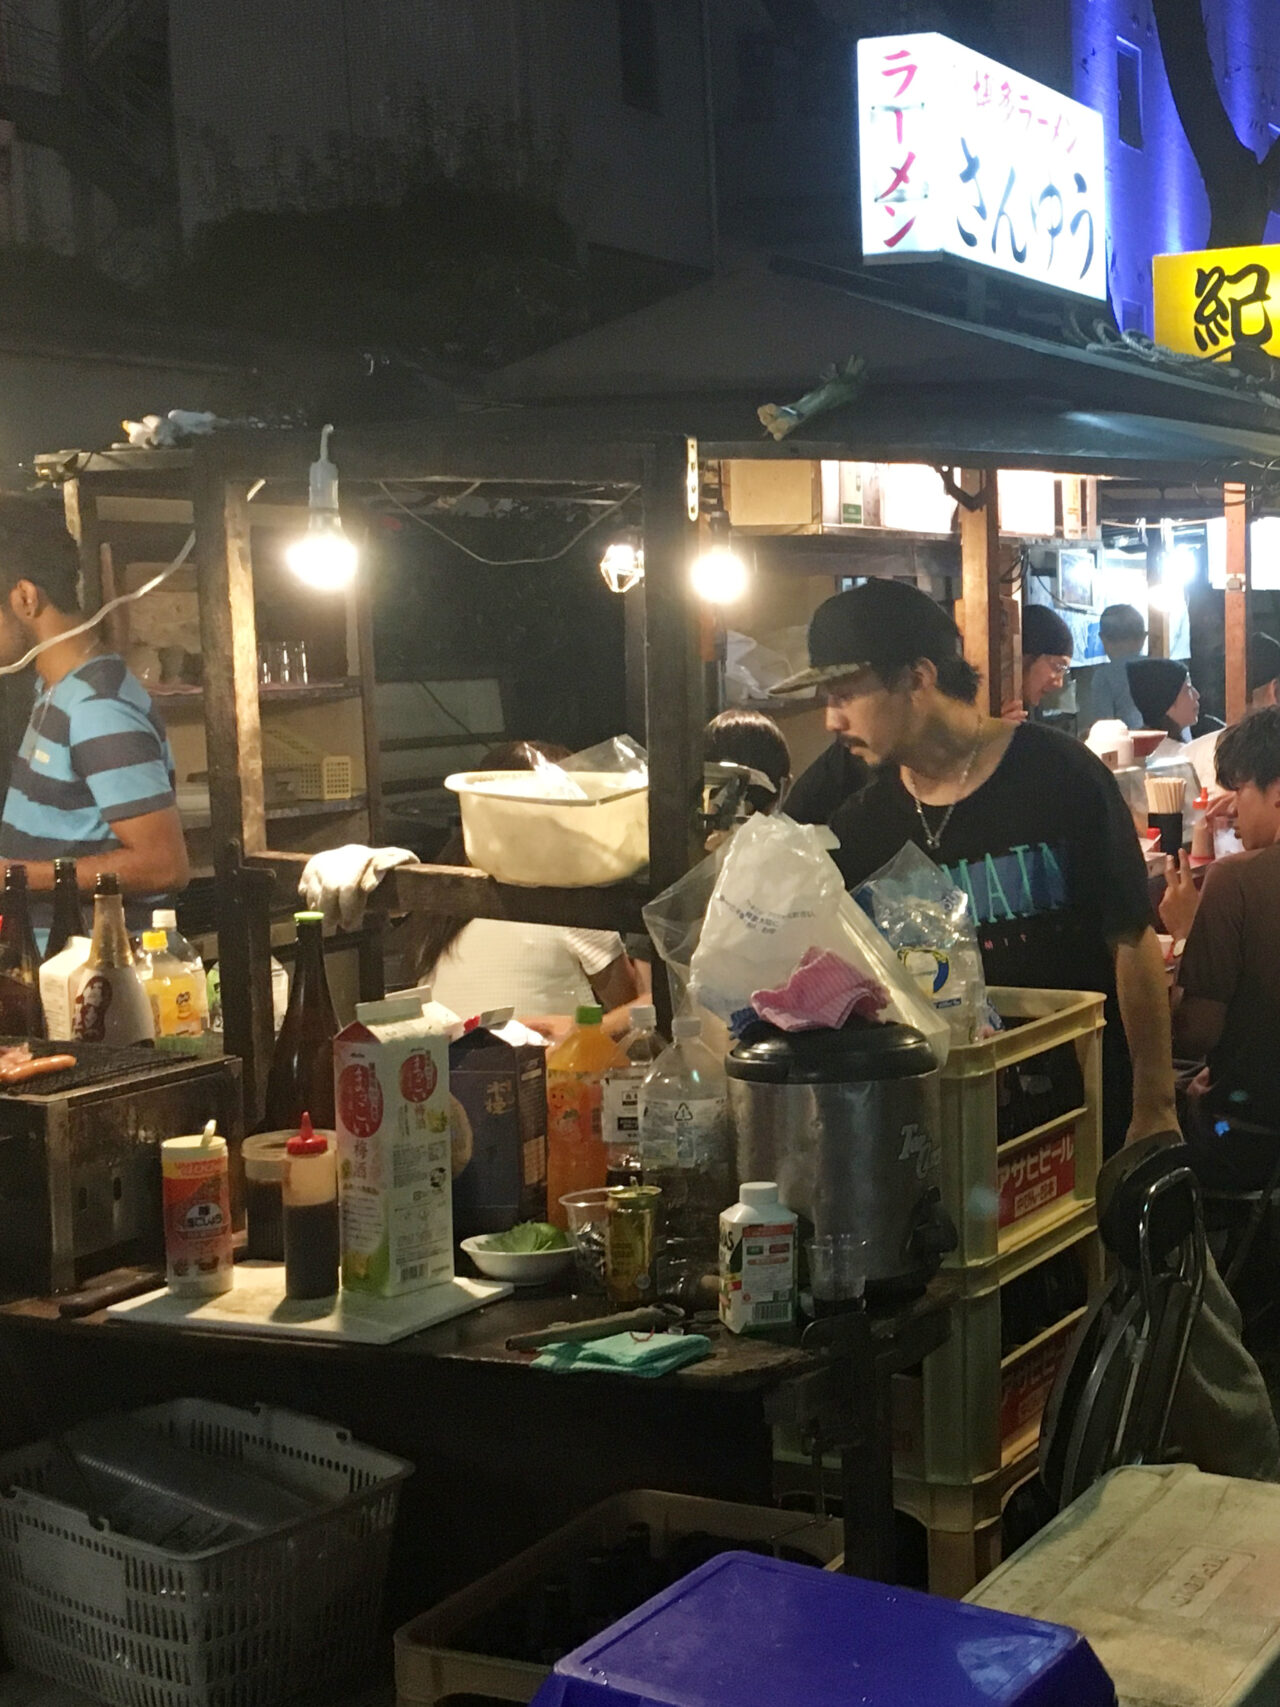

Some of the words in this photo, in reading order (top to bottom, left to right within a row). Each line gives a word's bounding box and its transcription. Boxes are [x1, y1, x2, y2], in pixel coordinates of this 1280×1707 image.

[879, 50, 918, 248] ラーメン
[956, 137, 1094, 280] さんゆう
[998, 1134, 1074, 1192] アサヒビール
